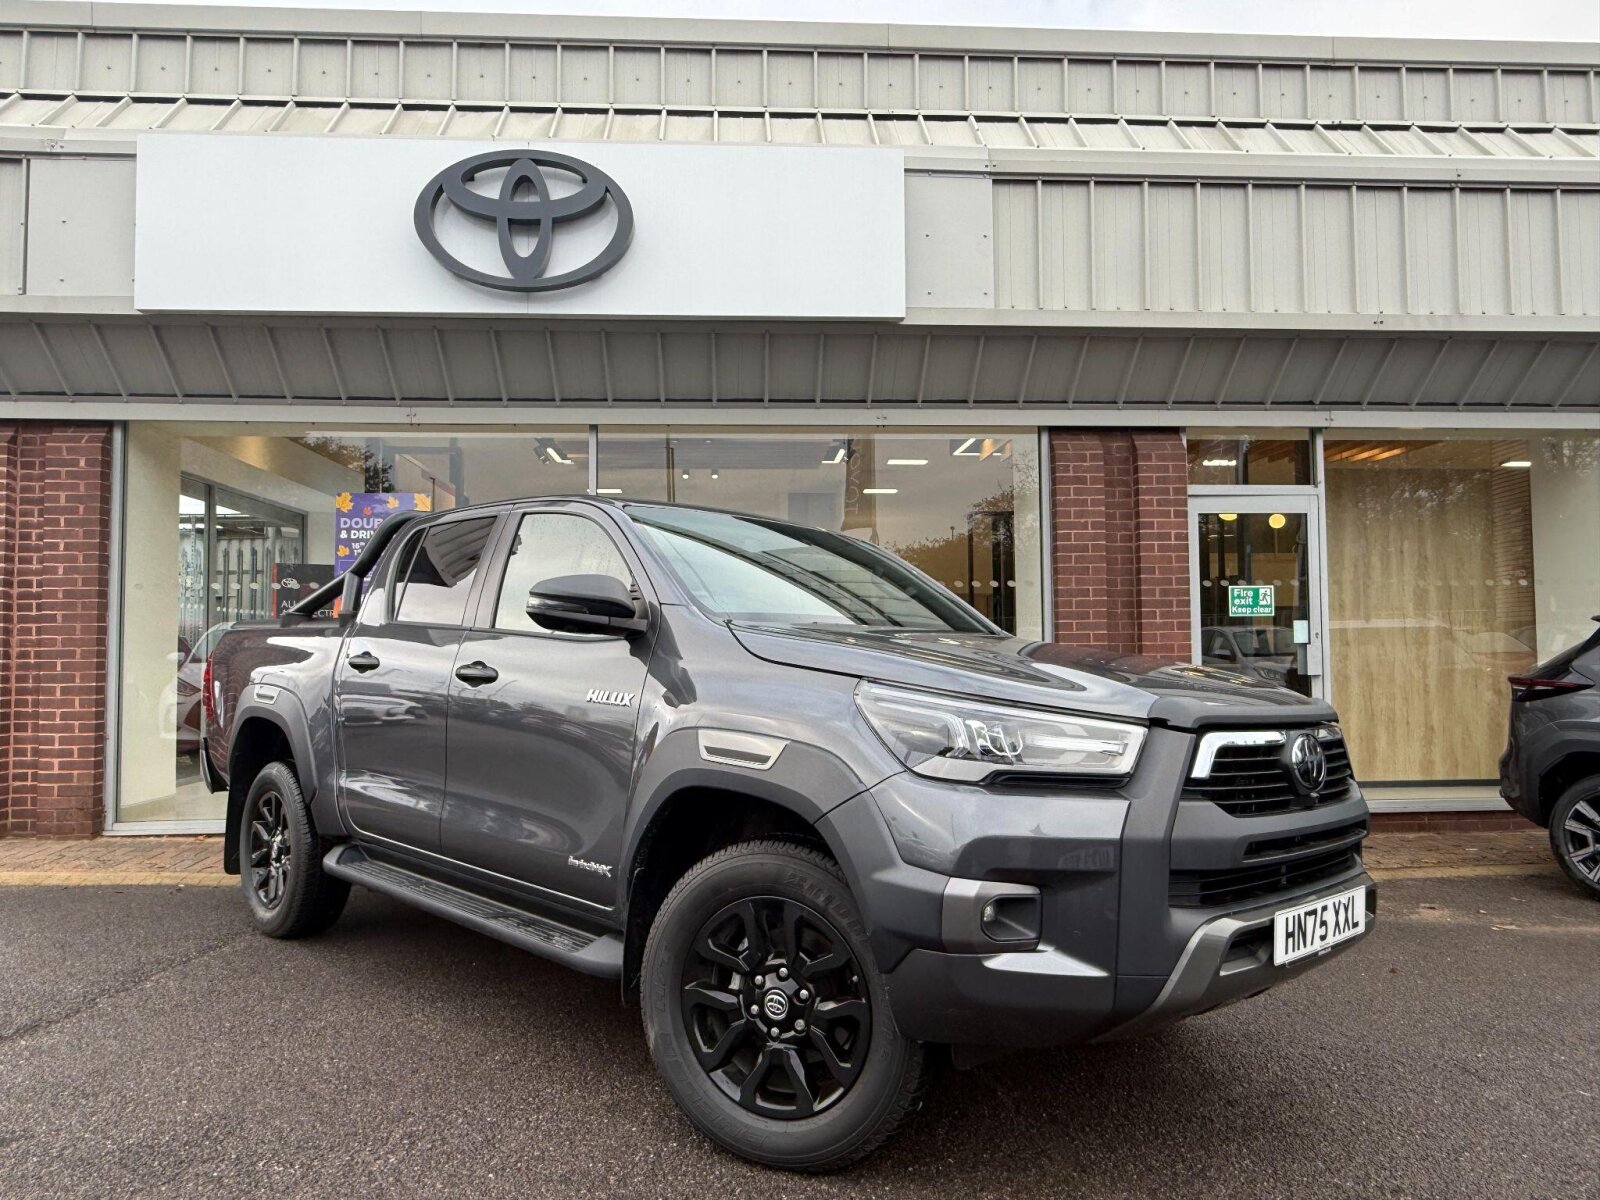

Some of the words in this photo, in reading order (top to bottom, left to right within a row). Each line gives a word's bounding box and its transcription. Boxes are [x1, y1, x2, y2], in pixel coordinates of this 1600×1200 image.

[1233, 588, 1254, 597] Fire
[1234, 597, 1253, 605] exit
[1231, 606, 1252, 614] Keep
[586, 689, 635, 707] HILUX
[1285, 905, 1328, 955] HN75
[1333, 895, 1359, 937] XXL
